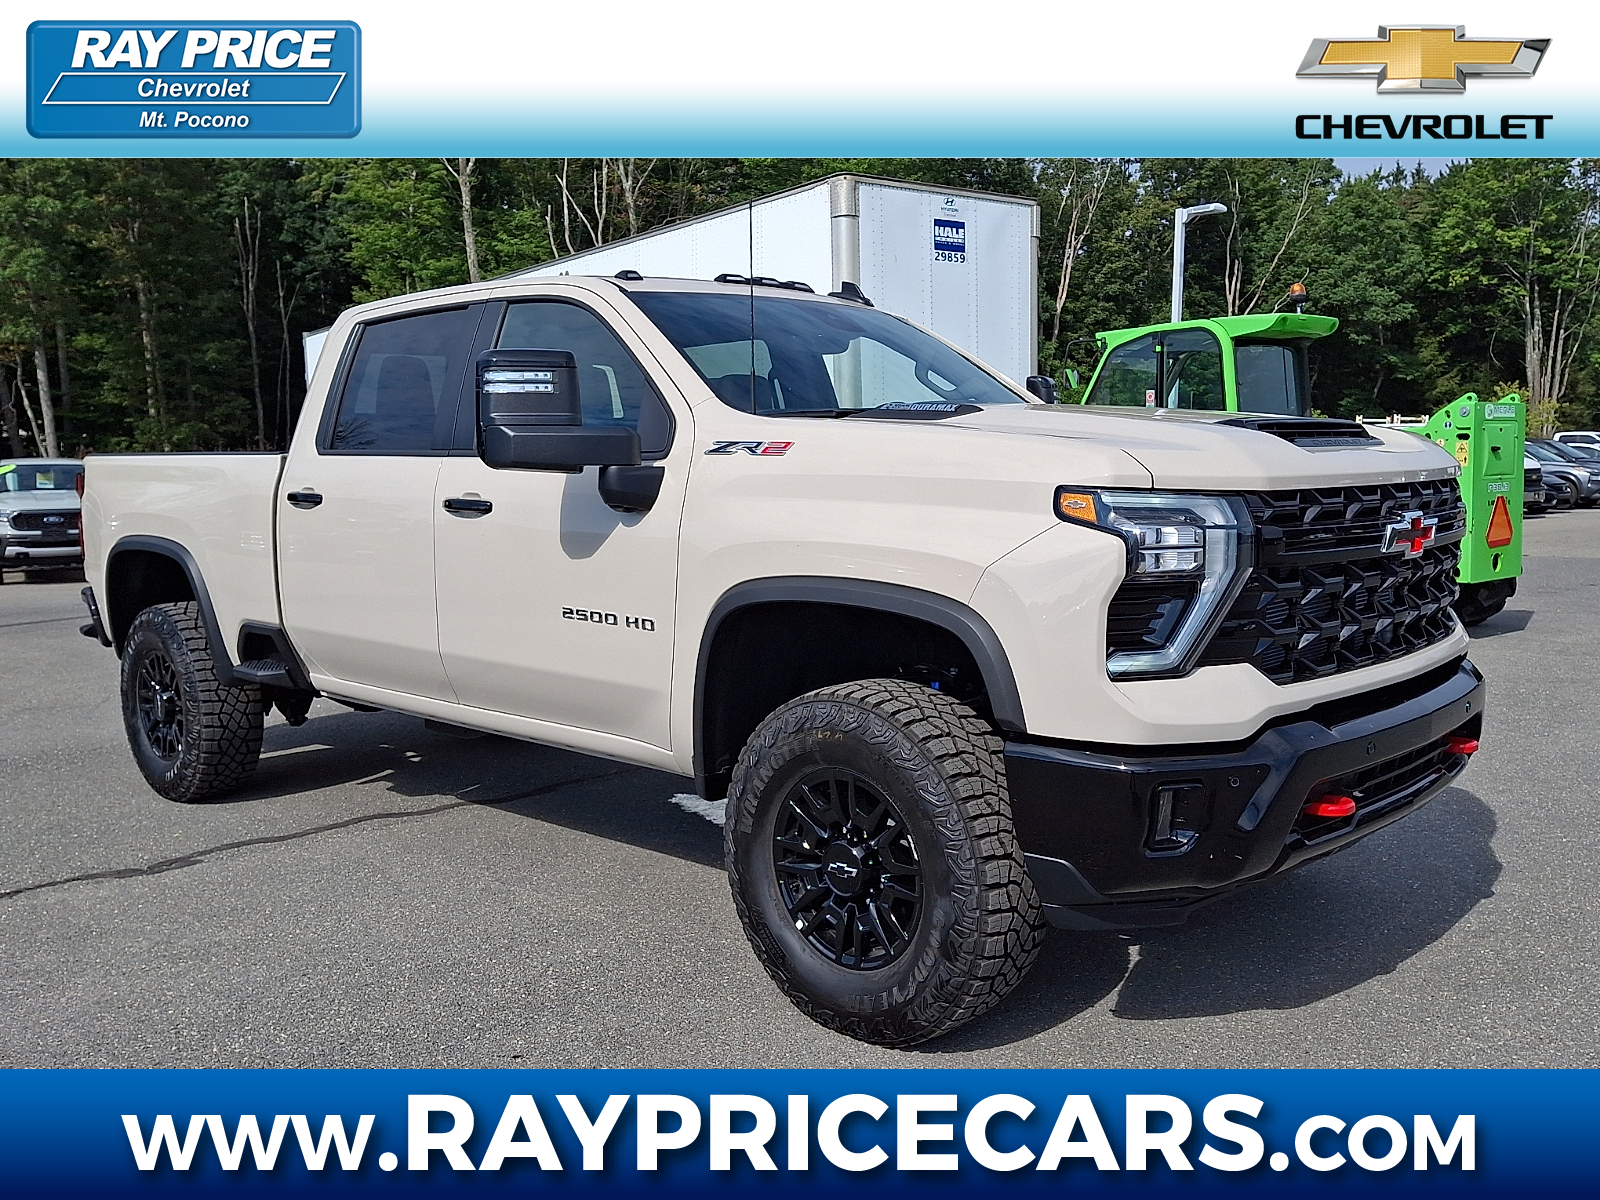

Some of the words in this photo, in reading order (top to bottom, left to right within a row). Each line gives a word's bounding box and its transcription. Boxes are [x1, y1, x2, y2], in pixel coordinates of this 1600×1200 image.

[934, 225, 965, 239] HALE
[934, 251, 966, 264] 29859
[910, 402, 959, 412] DURAMAX
[703, 440, 796, 457] ZR2
[562, 606, 619, 627] 2500
[625, 615, 656, 632] HD
